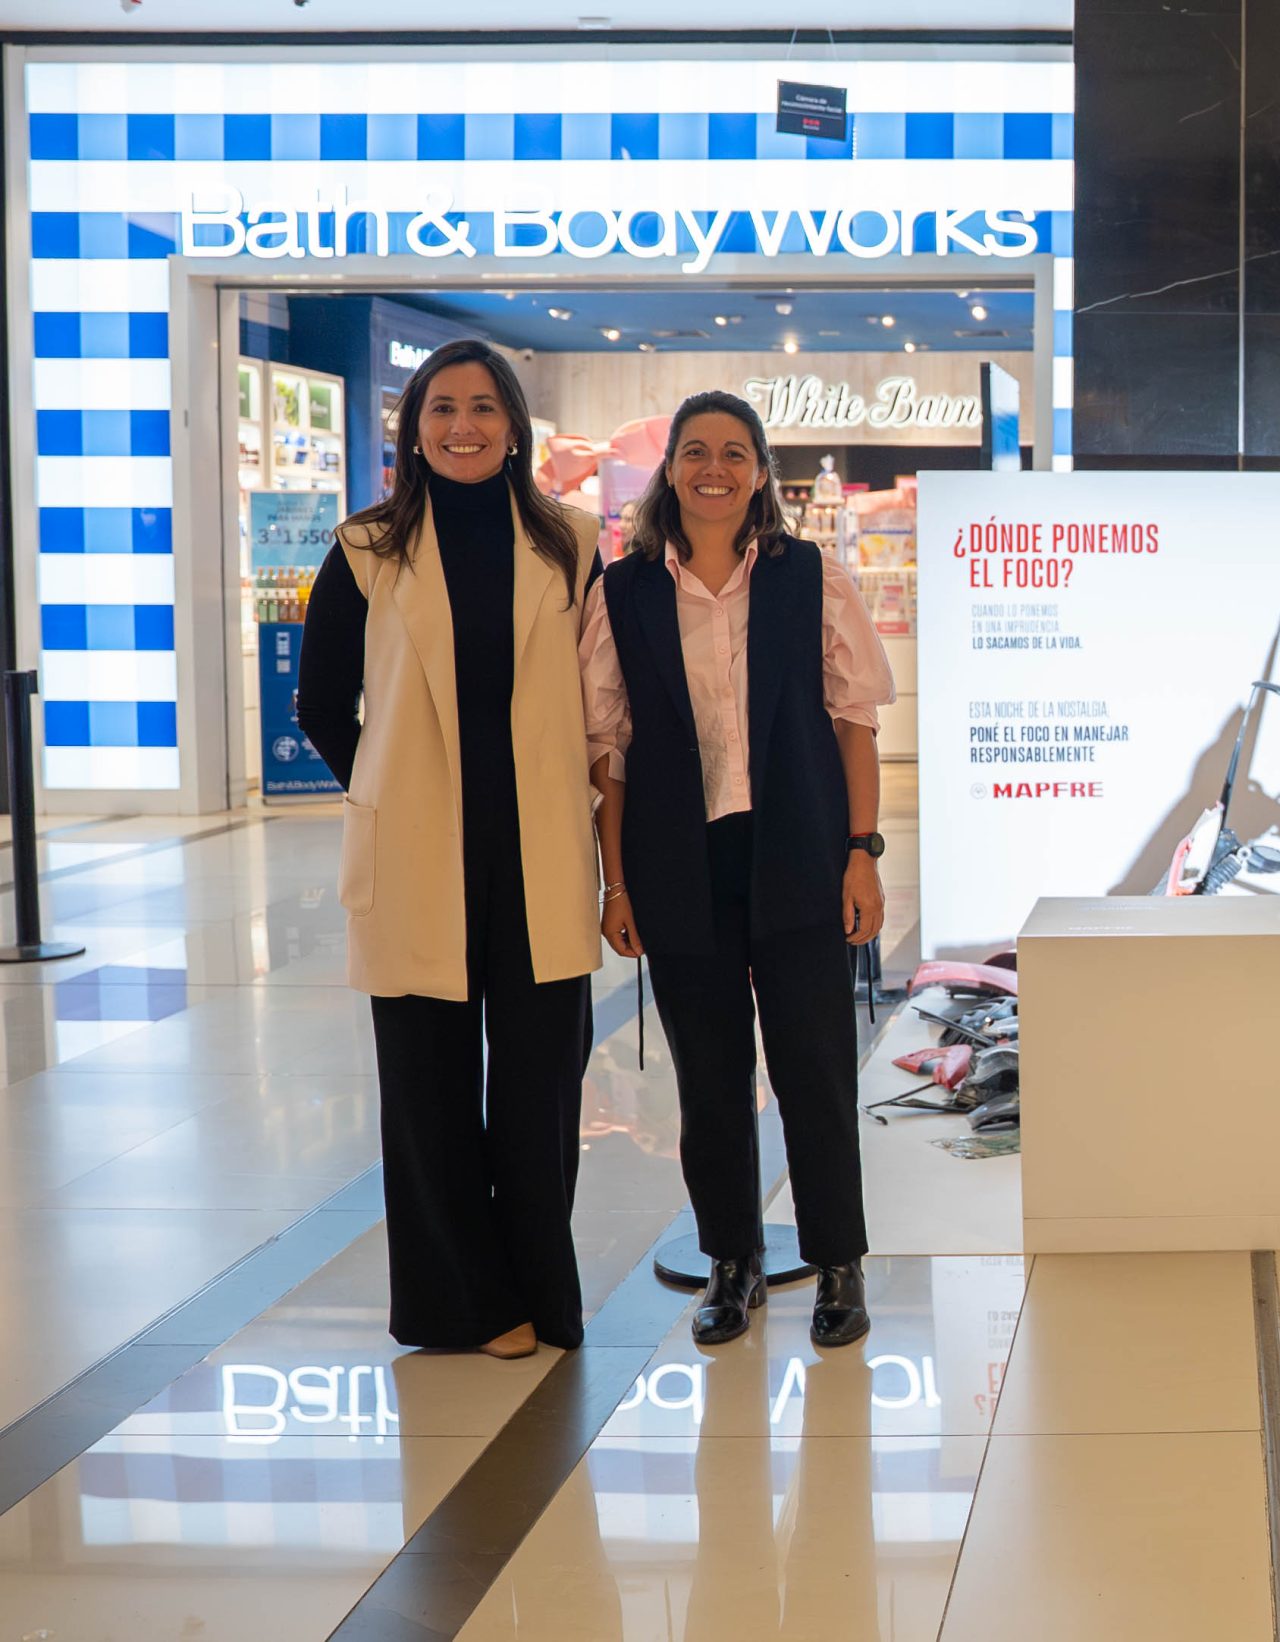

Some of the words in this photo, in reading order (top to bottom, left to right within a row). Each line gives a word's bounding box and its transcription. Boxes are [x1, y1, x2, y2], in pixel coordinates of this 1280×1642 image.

[181, 183, 388, 259] Bath
[406, 185, 477, 259] &
[493, 186, 733, 274] Body
[746, 186, 1040, 259] Works
[744, 375, 866, 428] White
[868, 376, 983, 429] Barn
[954, 516, 1043, 558] ¿DÓNDE
[1052, 523, 1159, 553] PONEMOS
[970, 558, 994, 588] EL
[1003, 558, 1074, 588] FOCO?
[971, 604, 1004, 617] CUANDO
[1007, 604, 1017, 617] LO
[1020, 604, 1059, 617] PONEMOS
[972, 620, 982, 633] EN
[986, 620, 1001, 633] UNA
[972, 636, 983, 649] LO
[986, 636, 1029, 649] SACAMOS
[1032, 636, 1042, 649] DE
[1046, 636, 1057, 649] LA
[1060, 636, 1083, 649] VIDA.
[969, 701, 991, 718] ESTA
[995, 701, 1024, 718] NOCHE
[1028, 701, 1039, 718] DE
[1043, 701, 1054, 718] LA
[970, 722, 999, 742] PONÉ
[1004, 726, 1016, 742] EL
[1021, 726, 1049, 742] FOCO
[1055, 726, 1069, 742] EN
[1074, 725, 1129, 742] MANEJAR
[970, 746, 1095, 763] RESPONSABLEMENTE
[993, 782, 1103, 798] MAPFRE
